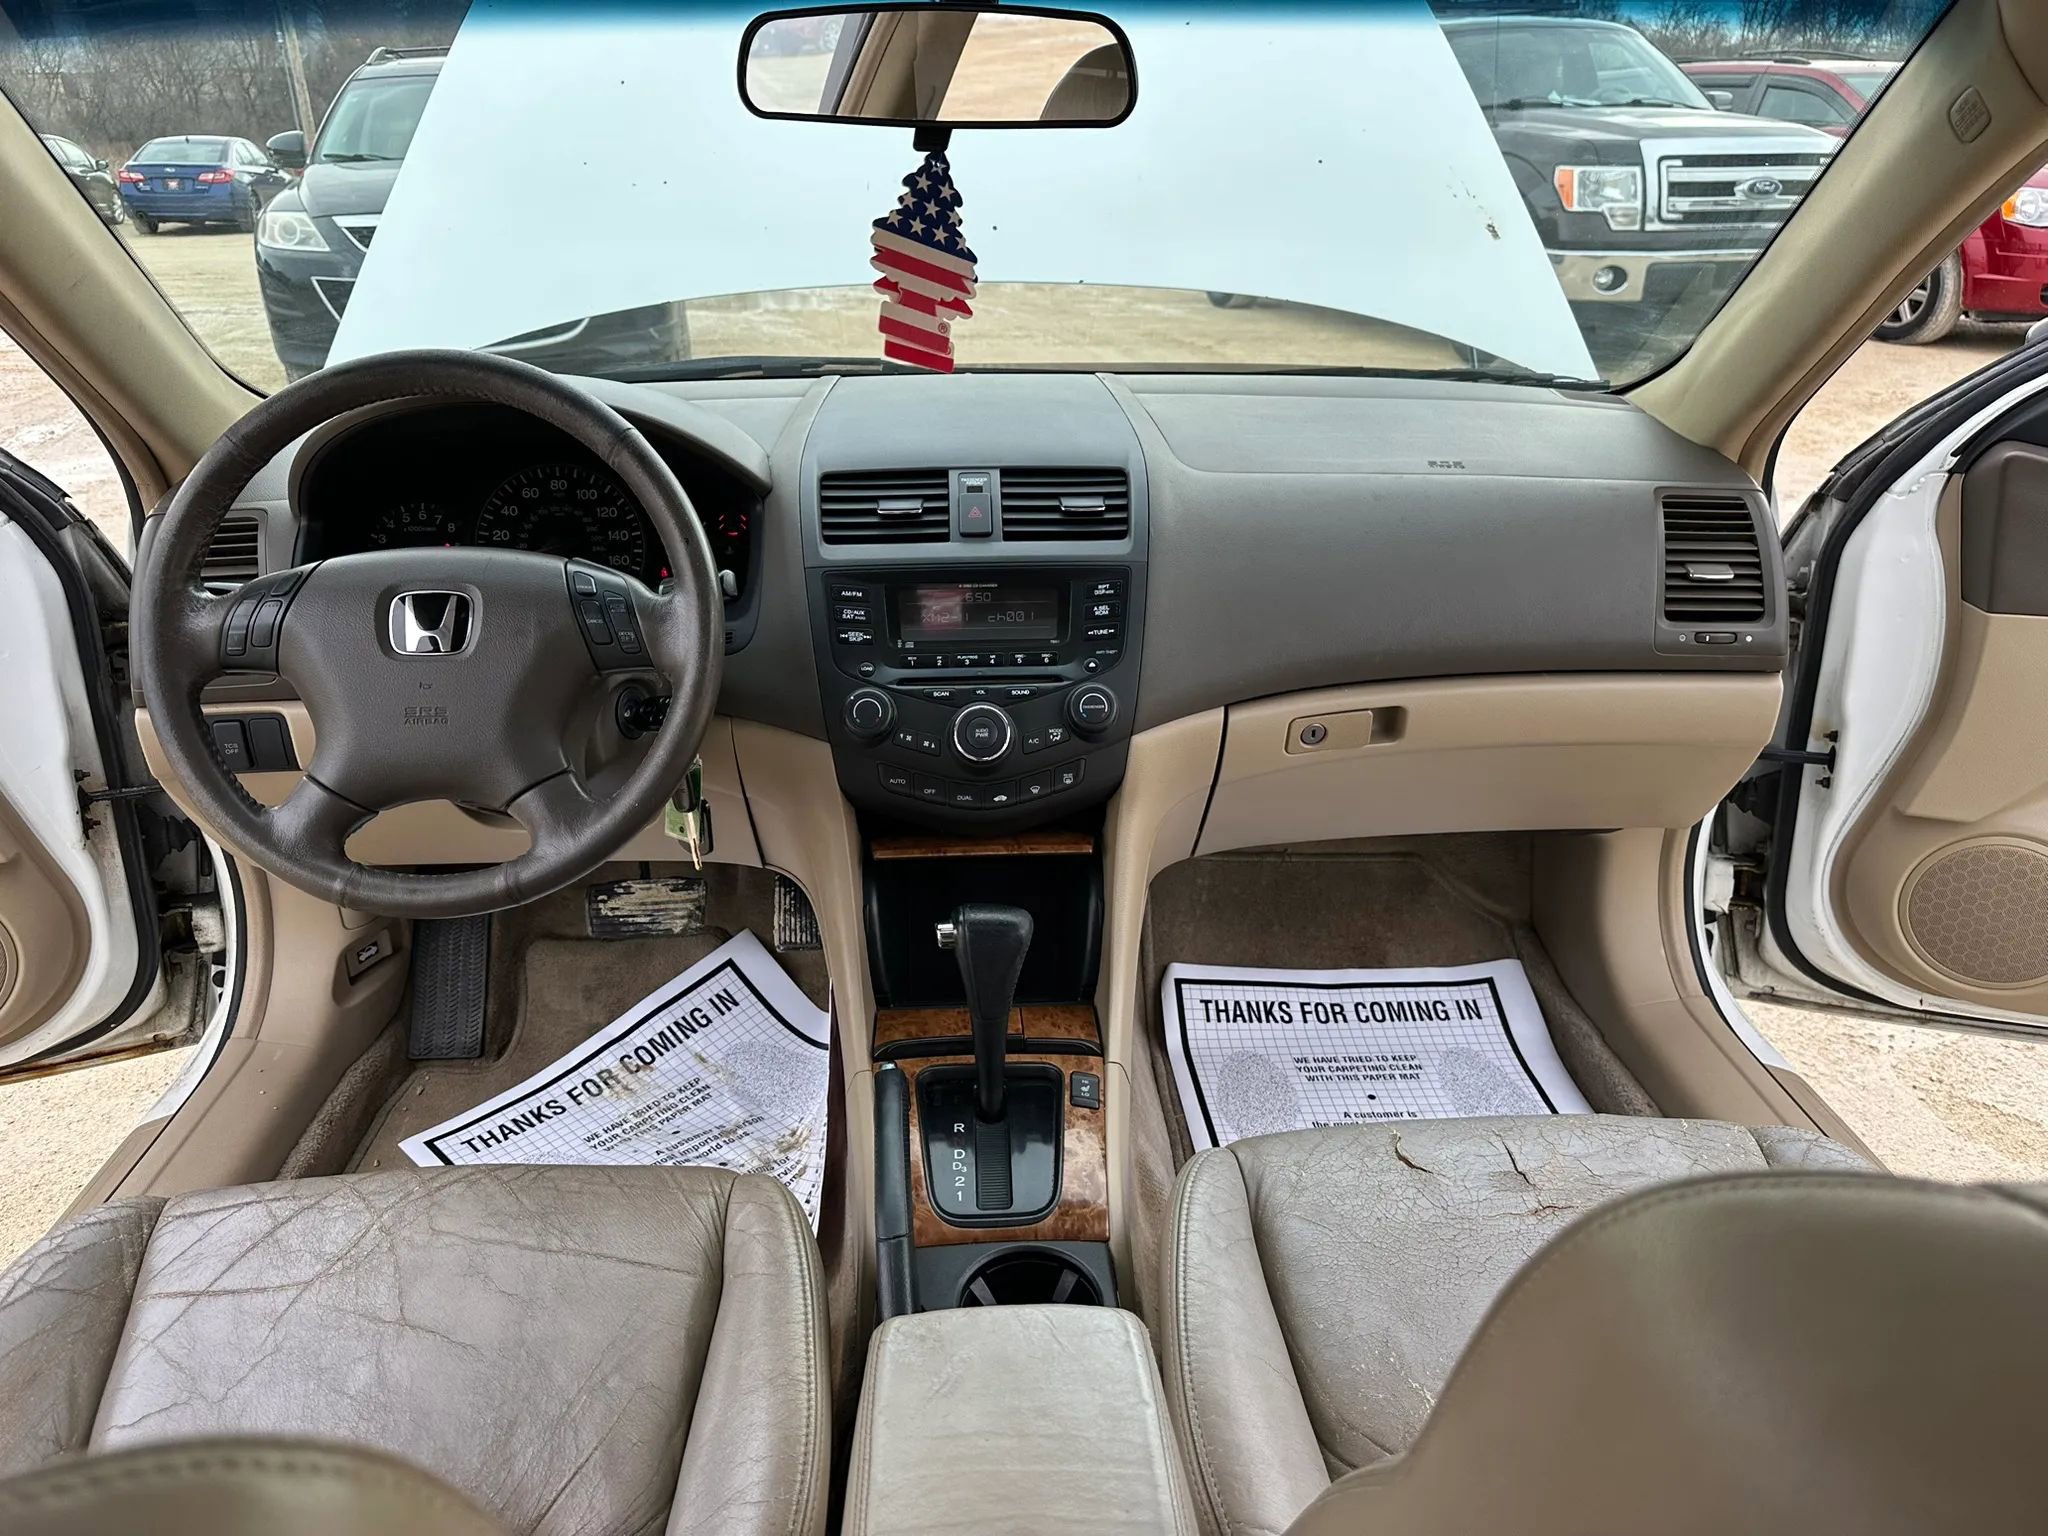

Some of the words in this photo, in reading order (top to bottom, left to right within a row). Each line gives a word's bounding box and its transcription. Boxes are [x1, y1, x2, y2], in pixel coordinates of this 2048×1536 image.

[550, 480, 567, 490] 80
[522, 488, 539, 498] 60
[576, 490, 598, 500] 100
[418, 510, 427, 520] 6
[501, 506, 518, 516] 40
[596, 506, 618, 518] 120
[402, 513, 410, 523] 5
[434, 515, 442, 524] 7
[387, 519, 395, 528] 4
[448, 523, 455, 532] 8
[378, 534, 386, 544] 3
[492, 530, 510, 540] 20
[608, 530, 629, 540] 140
[609, 555, 630, 566] 160
[1200, 1000, 1294, 1024] THANKS
[1300, 1001, 1348, 1025] FOR
[1354, 1000, 1451, 1024] COMING
[1456, 999, 1483, 1020] IN
[1341, 1055, 1372, 1063] TRIED
[460, 1098, 568, 1154] THANKS
[566, 1068, 620, 1107] FOR
[618, 1006, 713, 1076] COMING
[708, 988, 740, 1016] IN
[1296, 1065, 1325, 1073] YOUR
[1305, 1074, 1333, 1082] WITH
[1362, 1073, 1397, 1081] PAPER
[1399, 1072, 1421, 1080] MAT
[583, 1132, 602, 1143] WE
[602, 1117, 629, 1134] HAVE
[630, 1100, 660, 1118] TRIED
[661, 1092, 676, 1102] TO
[676, 1077, 701, 1094] KEEP
[634, 1125, 659, 1138] THIS
[659, 1106, 692, 1126] PAPER
[692, 1092, 713, 1107] MAT
[1343, 1111, 1352, 1119] A
[1354, 1111, 1404, 1119] customer
[590, 1133, 620, 1150] YOUR
[622, 1101, 679, 1135] CARPETING
[678, 1084, 711, 1104] CLEAN
[953, 1123, 966, 1133] R
[1312, 1121, 1329, 1129] the
[667, 1128, 713, 1152] customer
[672, 1157, 692, 1166] the
[693, 1143, 723, 1160] world
[723, 1137, 736, 1145] to
[954, 1150, 966, 1159] D
[954, 1176, 966, 1187] 2
[956, 1191, 963, 1201] 1
